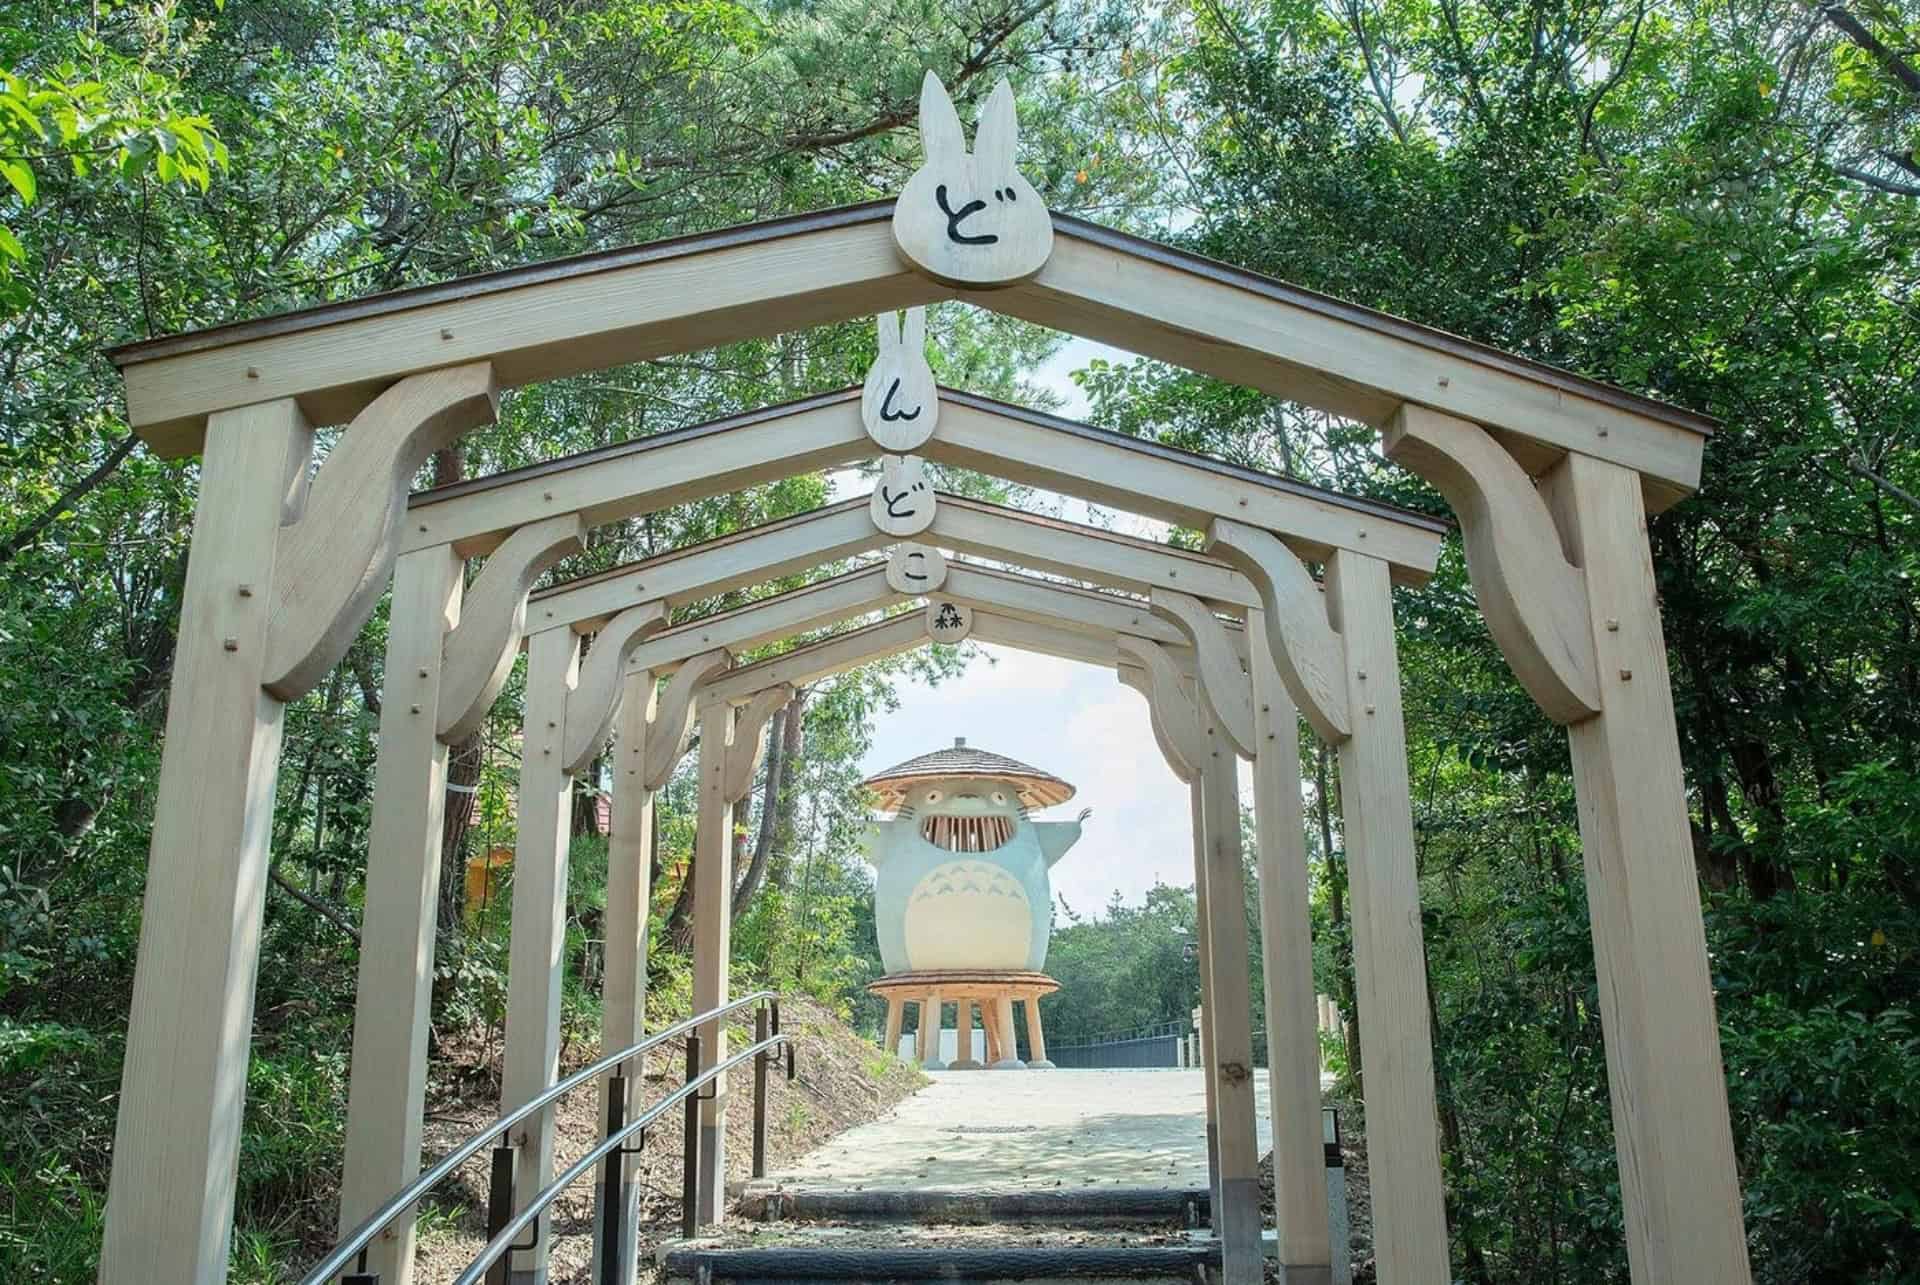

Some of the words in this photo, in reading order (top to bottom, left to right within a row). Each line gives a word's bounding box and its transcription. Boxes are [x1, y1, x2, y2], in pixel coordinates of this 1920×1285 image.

[935, 184, 1017, 246] ど
[880, 378, 921, 422] ん
[882, 482, 925, 518] ど
[905, 552, 928, 581] こ
[934, 603, 964, 630] 森
